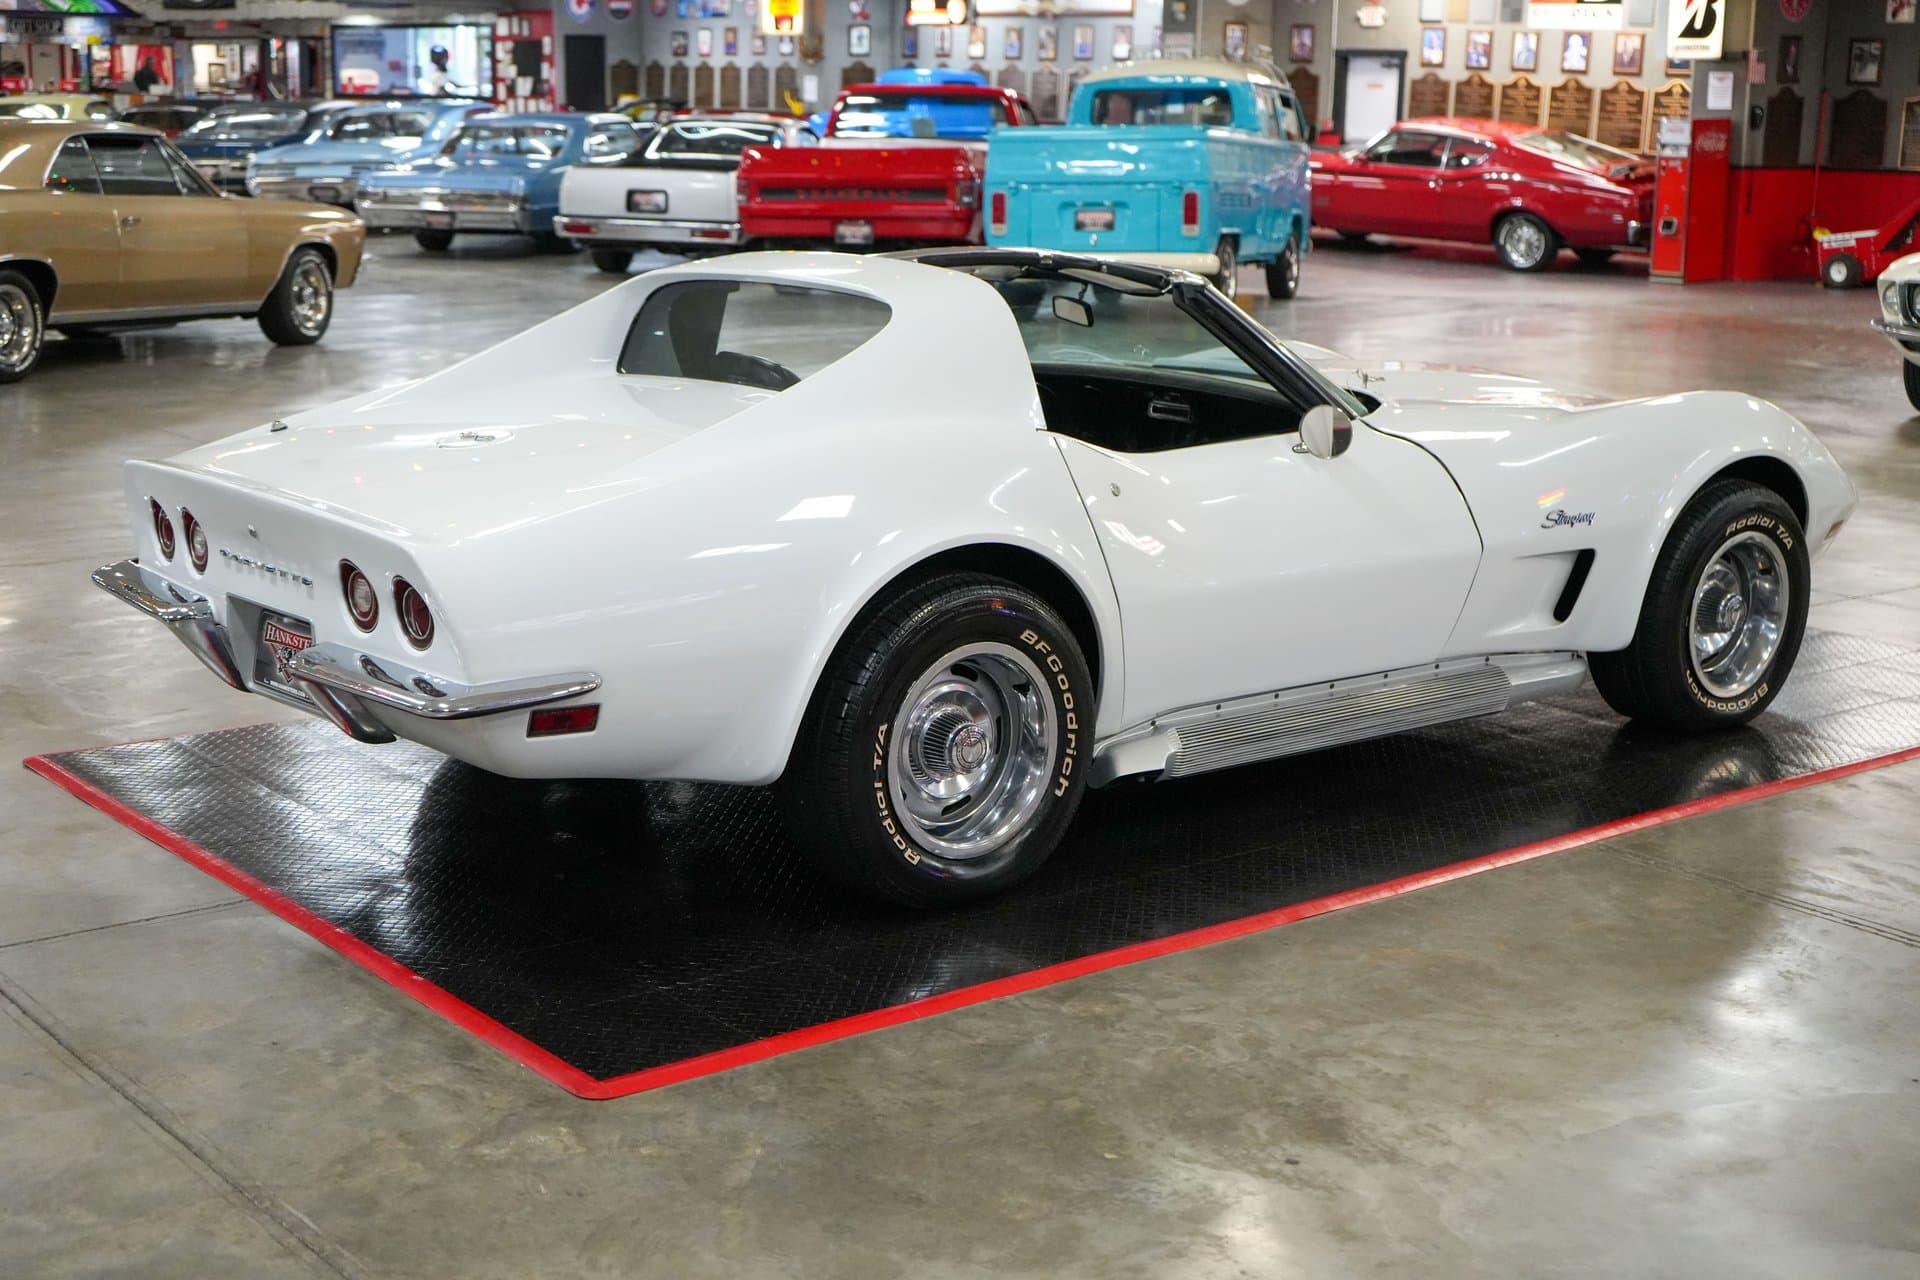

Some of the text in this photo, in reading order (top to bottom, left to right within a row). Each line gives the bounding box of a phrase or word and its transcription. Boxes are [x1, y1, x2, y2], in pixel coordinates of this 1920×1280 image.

[1726, 514, 1794, 550] Radial T/A
[266, 624, 312, 649] HANKSTE
[1686, 669, 1769, 711] BFGoodrich
[1020, 629, 1078, 798] BFGoodrich
[873, 723, 921, 866] Radial T/A
